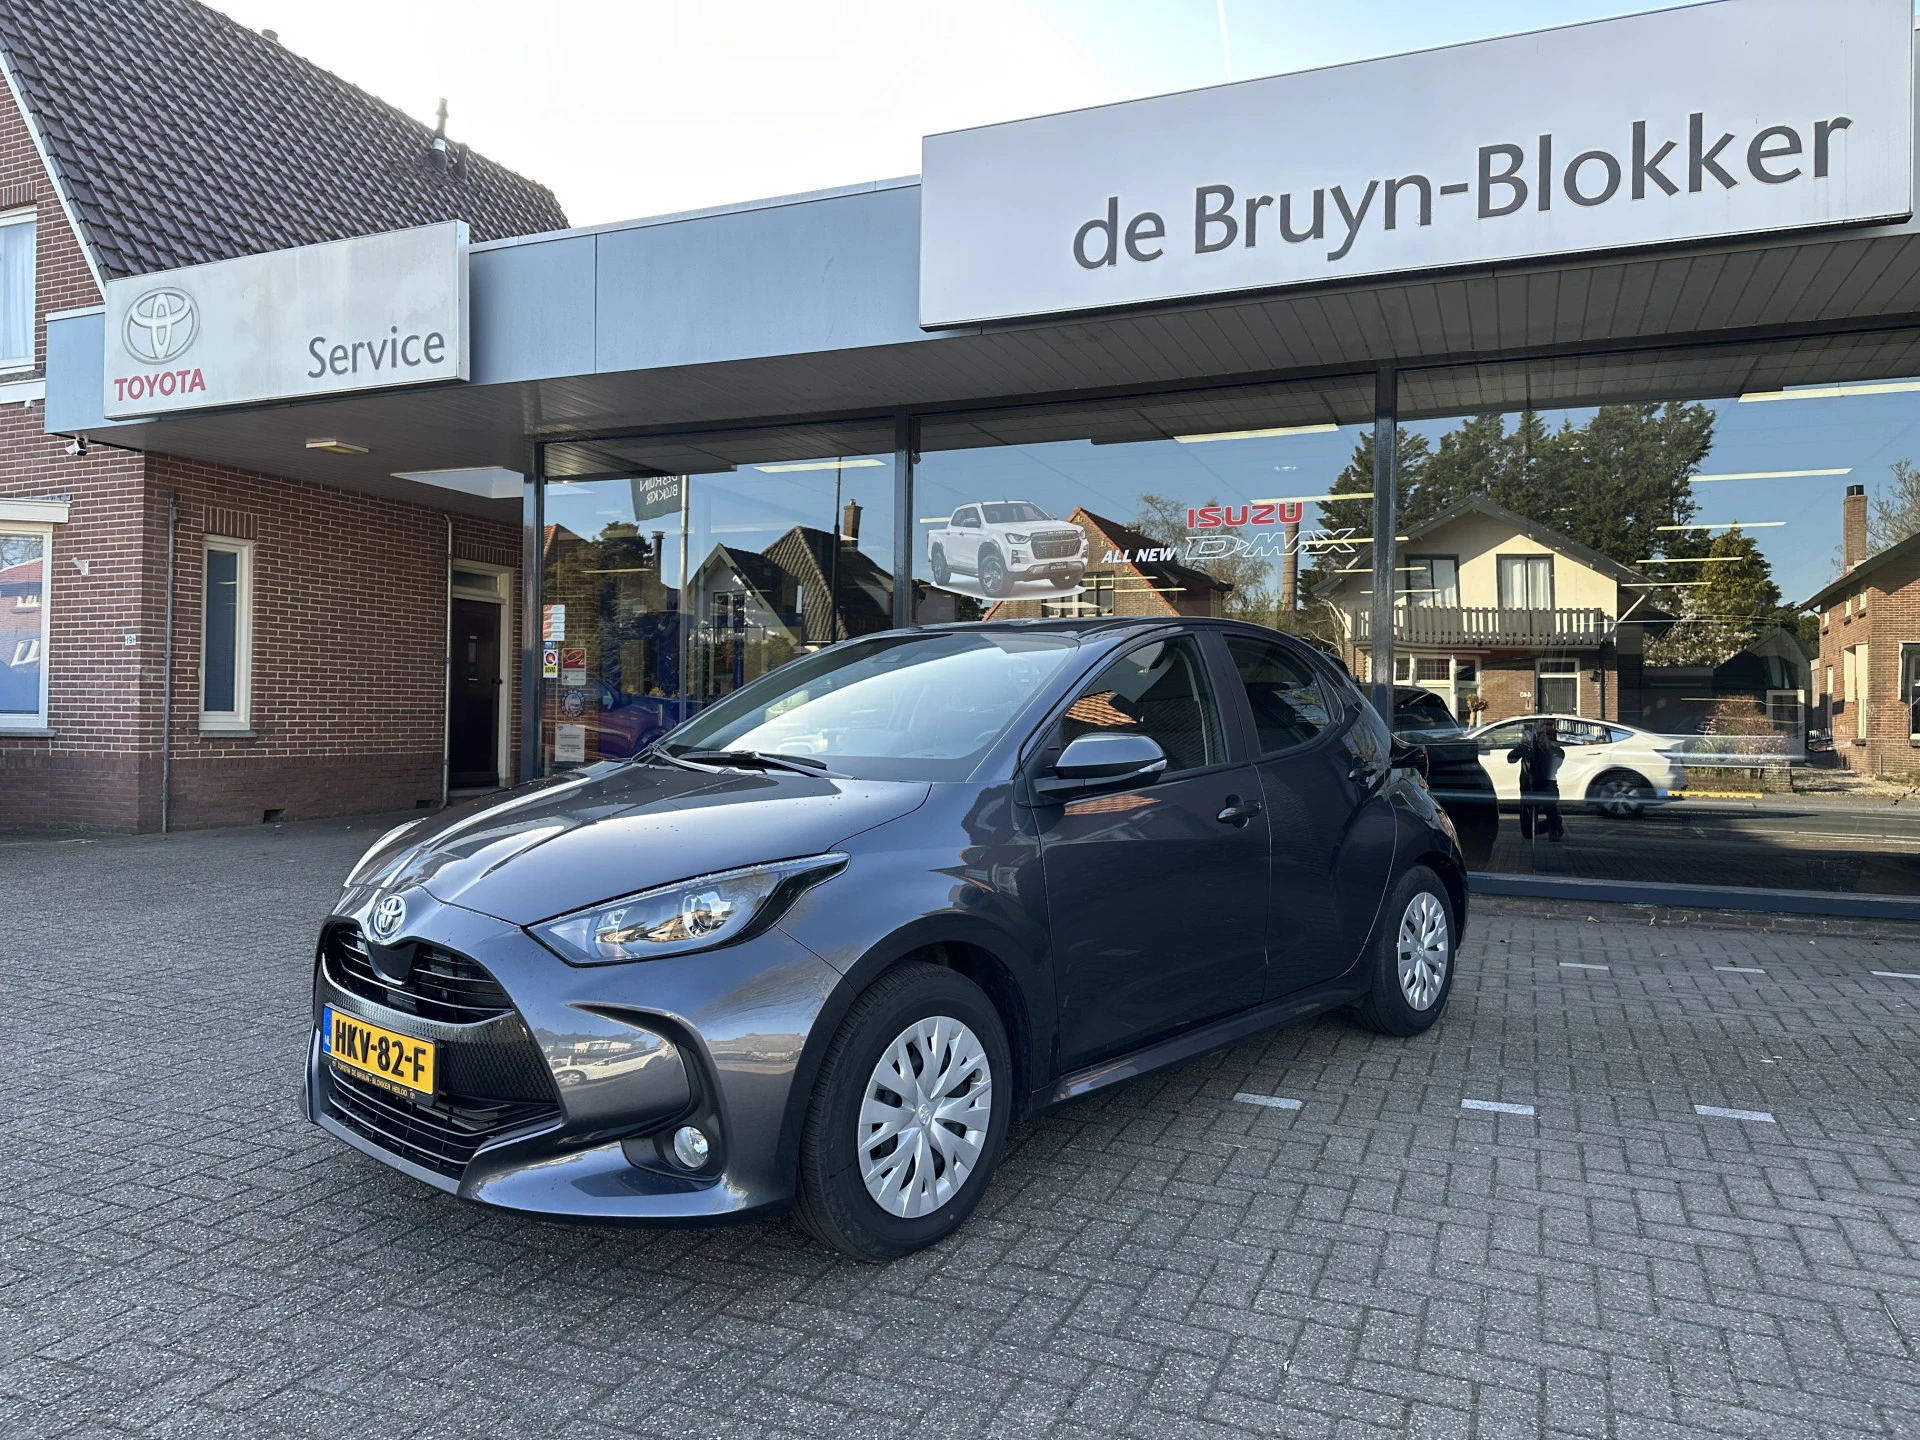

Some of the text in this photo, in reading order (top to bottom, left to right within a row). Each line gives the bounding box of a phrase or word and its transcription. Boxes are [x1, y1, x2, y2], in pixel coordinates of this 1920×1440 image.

[1073, 112, 1854, 270] de Bruyn-Blokker
[307, 325, 445, 379] Service
[114, 368, 206, 401] TOYOTA
[1187, 502, 1303, 528] ISUZU
[1101, 547, 1177, 564] ALL NEW
[324, 1034, 331, 1047] NL
[335, 1019, 426, 1082] HKV-82-F
